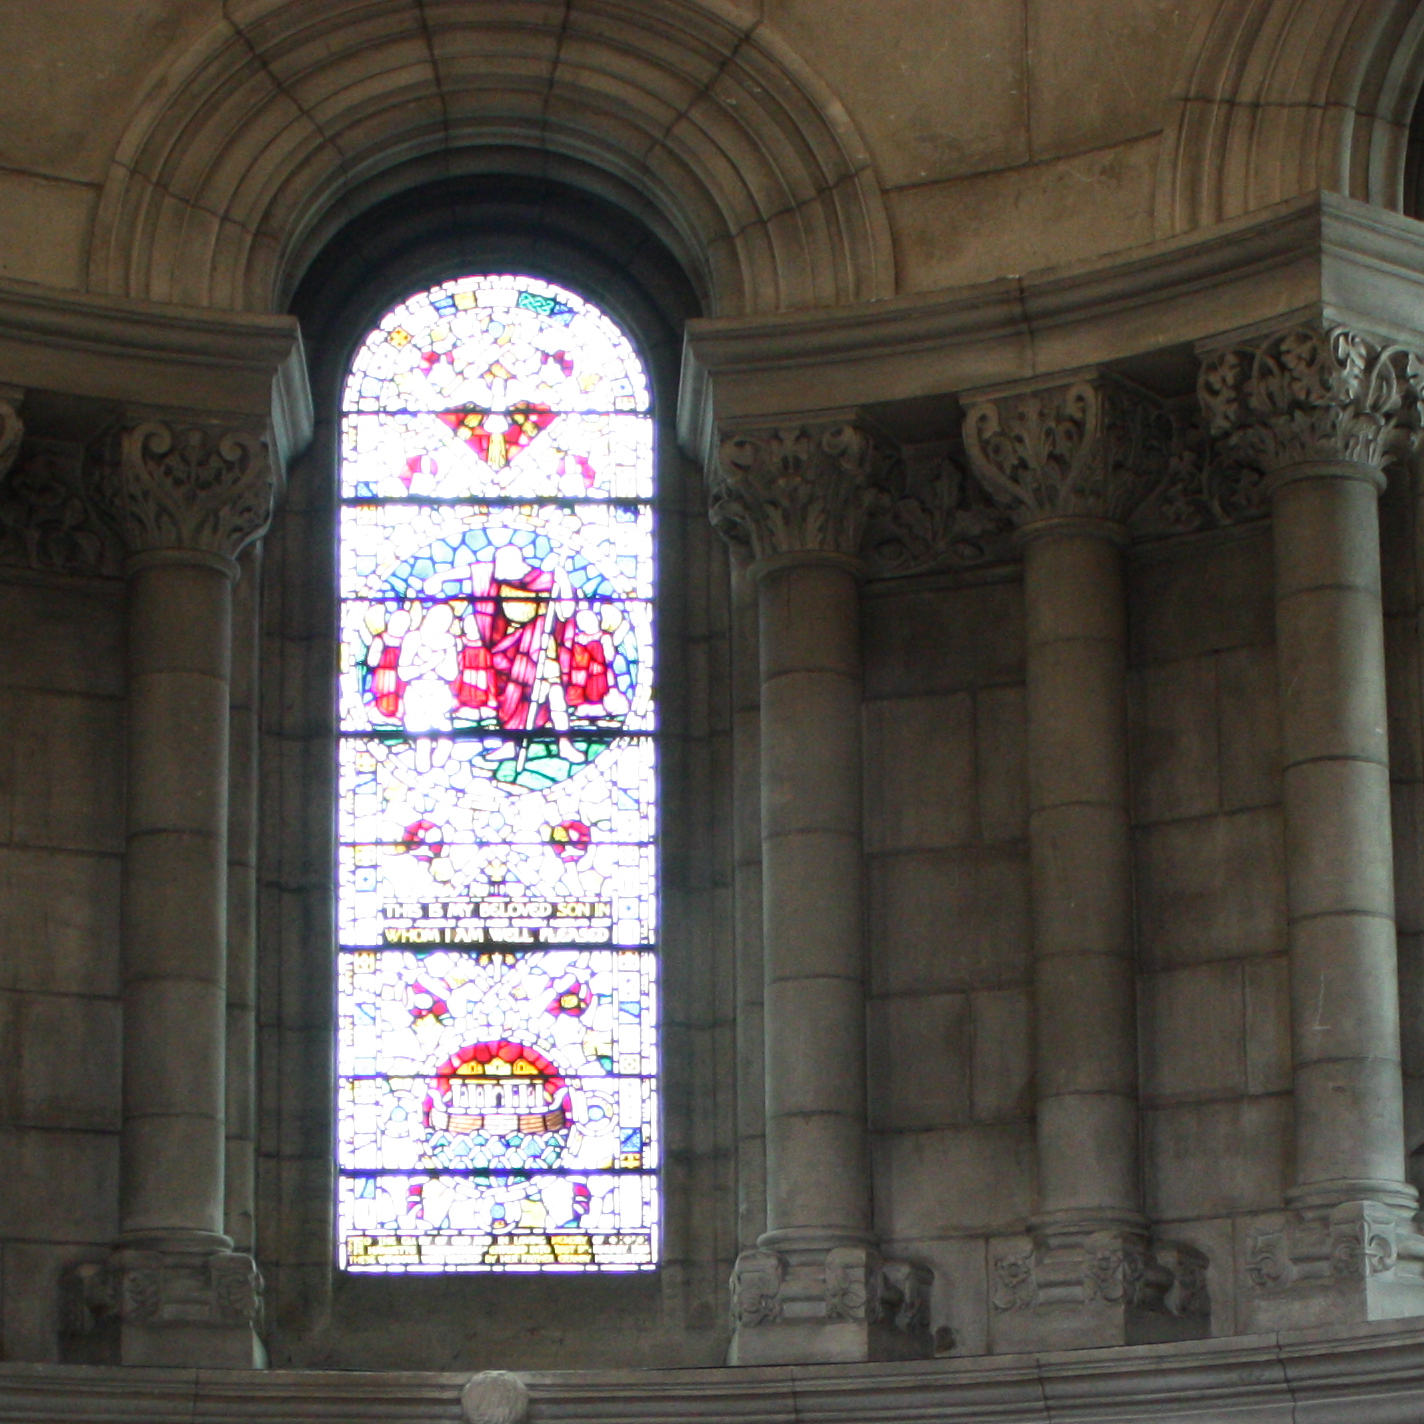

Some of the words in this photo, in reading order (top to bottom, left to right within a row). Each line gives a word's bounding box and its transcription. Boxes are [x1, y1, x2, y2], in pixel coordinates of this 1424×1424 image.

[383, 903, 423, 918] THIS
[428, 903, 444, 918] IS
[447, 903, 475, 918] MY
[480, 903, 552, 918] BELOVED
[556, 903, 590, 918] SON
[594, 903, 611, 918] IN
[384, 927, 440, 943] WHOM
[445, 928, 451, 943] I
[454, 928, 484, 943] AM
[488, 927, 533, 943] WELL
[538, 927, 610, 943] PLEASED
